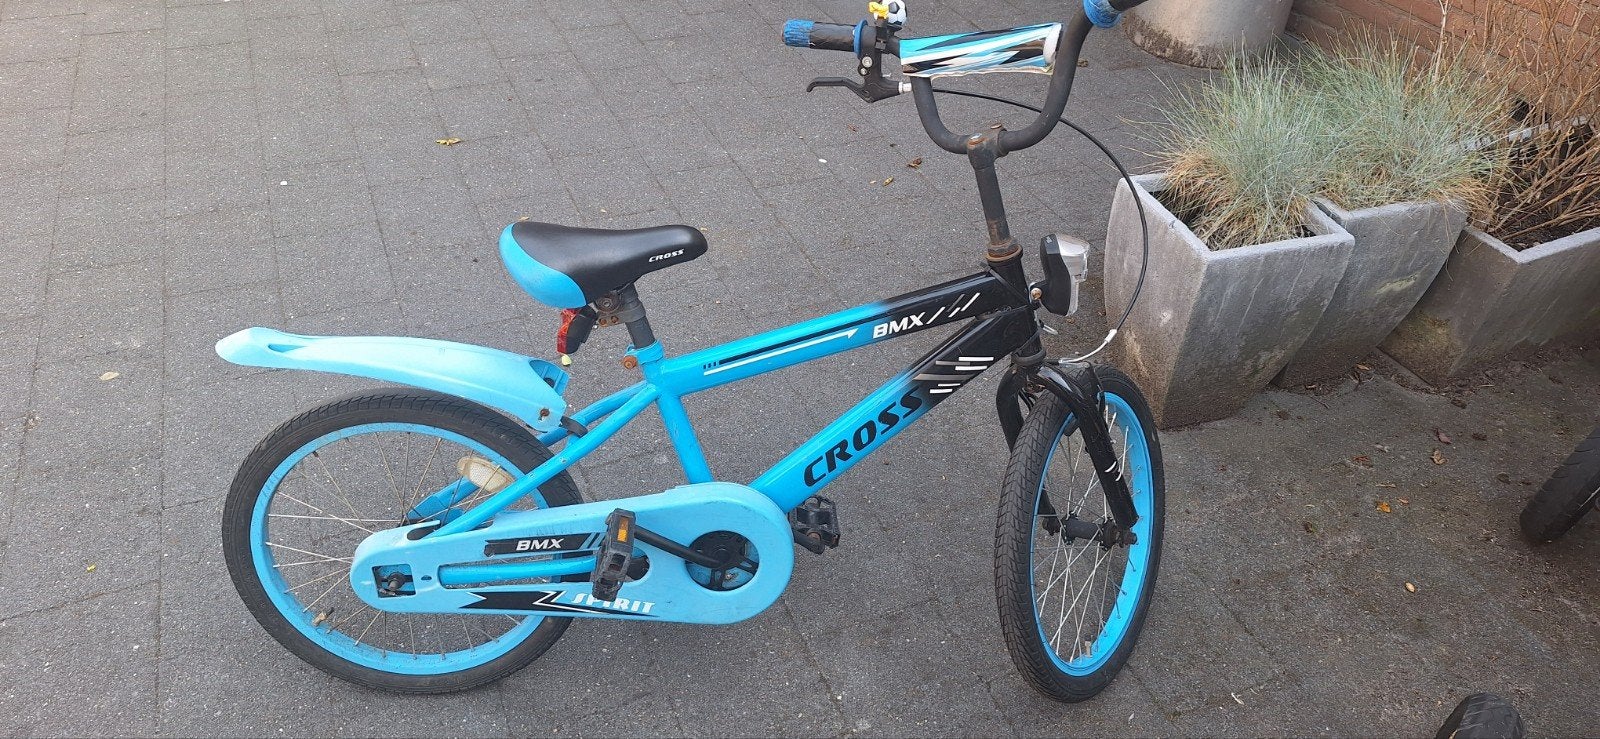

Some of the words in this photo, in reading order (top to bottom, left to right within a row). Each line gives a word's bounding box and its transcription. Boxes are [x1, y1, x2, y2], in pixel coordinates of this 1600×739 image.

[648, 248, 685, 263] CROSS
[872, 311, 926, 339] BMX
[803, 386, 924, 488] CROSS
[515, 538, 565, 551] BMX
